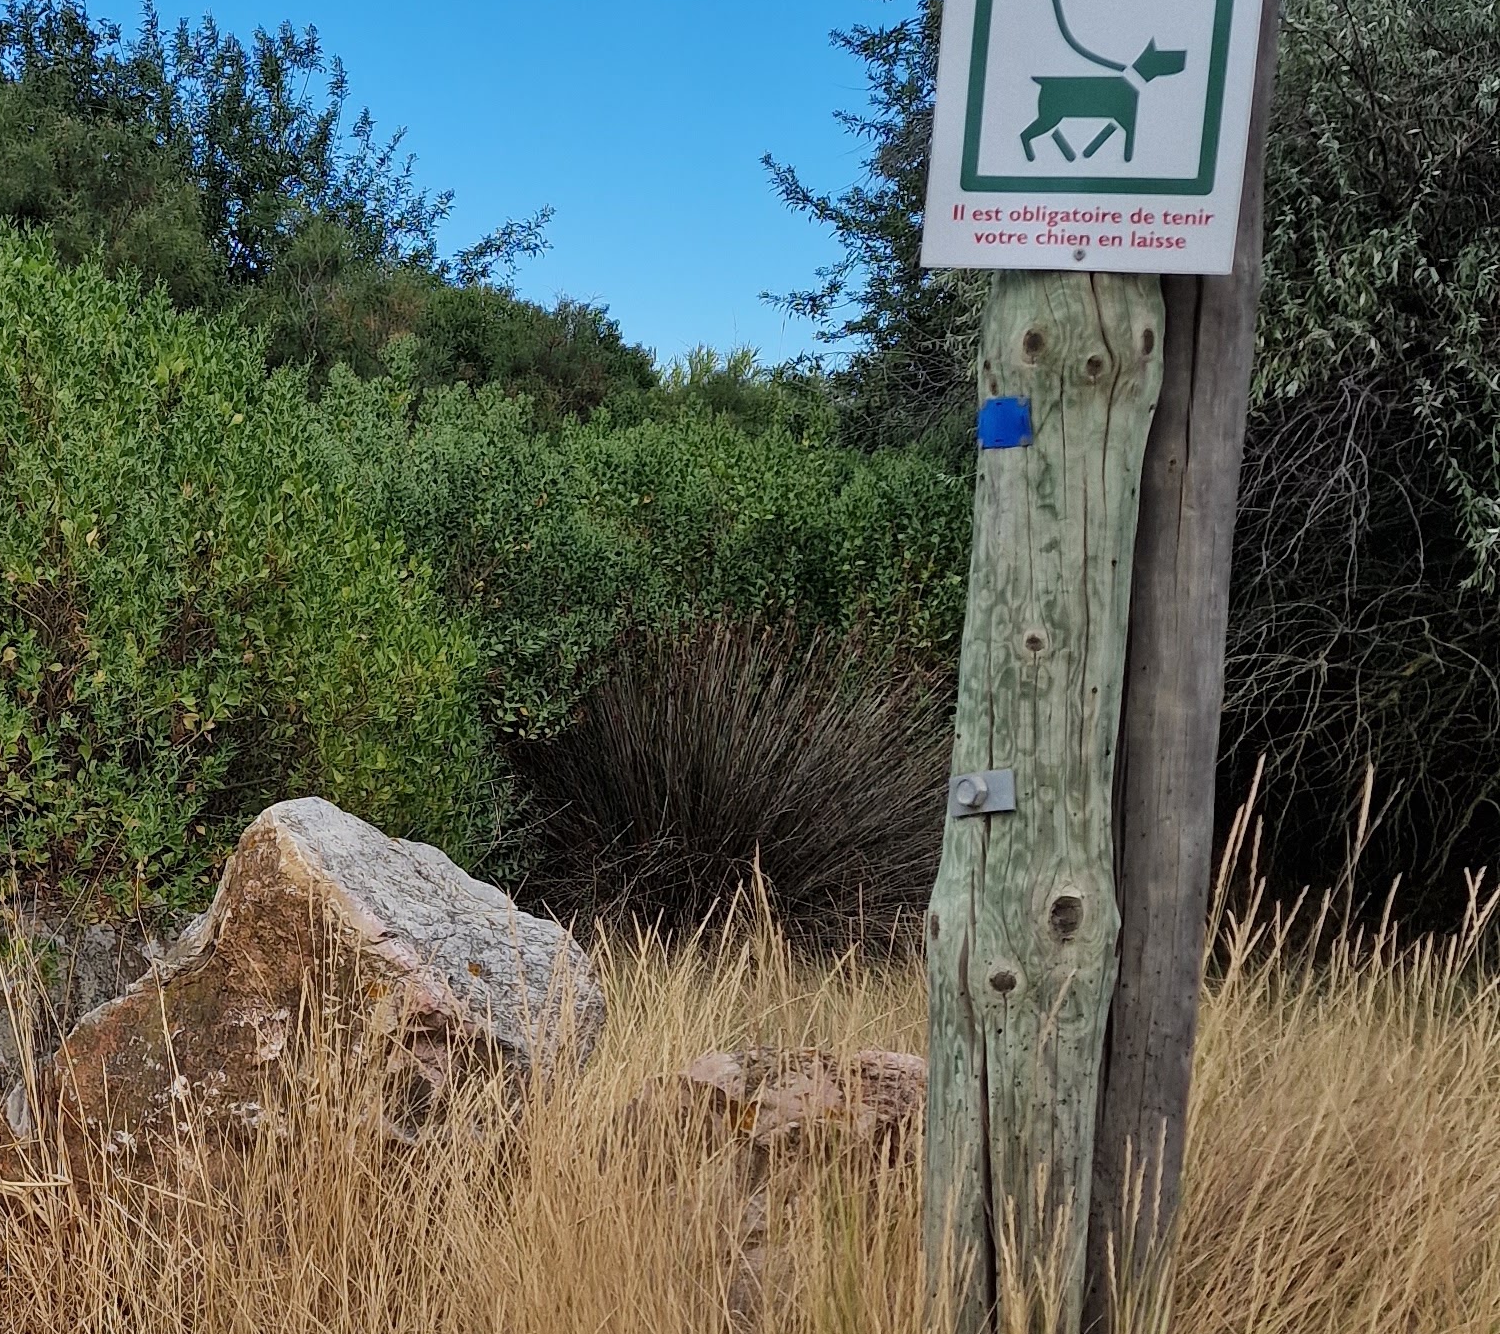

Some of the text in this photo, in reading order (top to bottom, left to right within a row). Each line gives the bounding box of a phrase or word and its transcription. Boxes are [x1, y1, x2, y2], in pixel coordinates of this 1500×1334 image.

[952, 204, 1214, 227] Il est obligatoire de tenir
[974, 229, 1186, 249] votre chien en laisse
